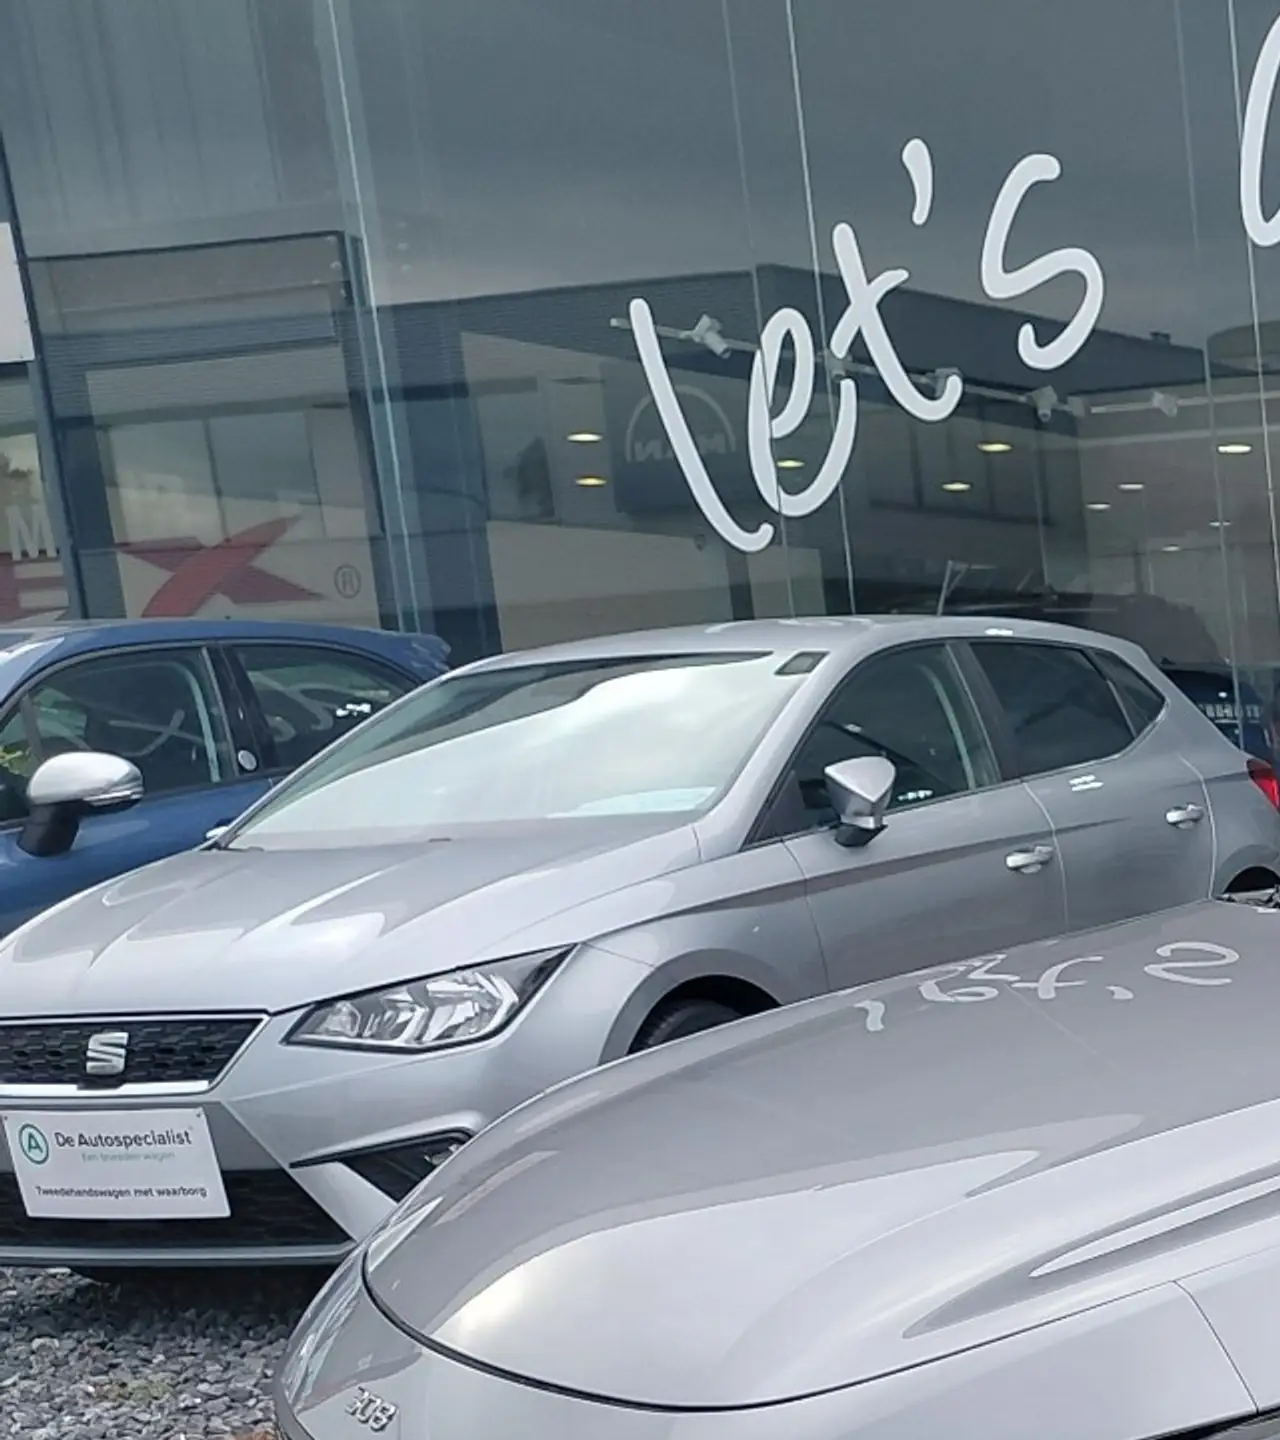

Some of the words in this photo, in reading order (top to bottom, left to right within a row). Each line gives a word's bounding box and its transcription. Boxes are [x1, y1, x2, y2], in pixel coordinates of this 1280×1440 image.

[629, 138, 1105, 553] let's
[54, 1131, 75, 1148] De
[343, 1385, 396, 1433] 308
